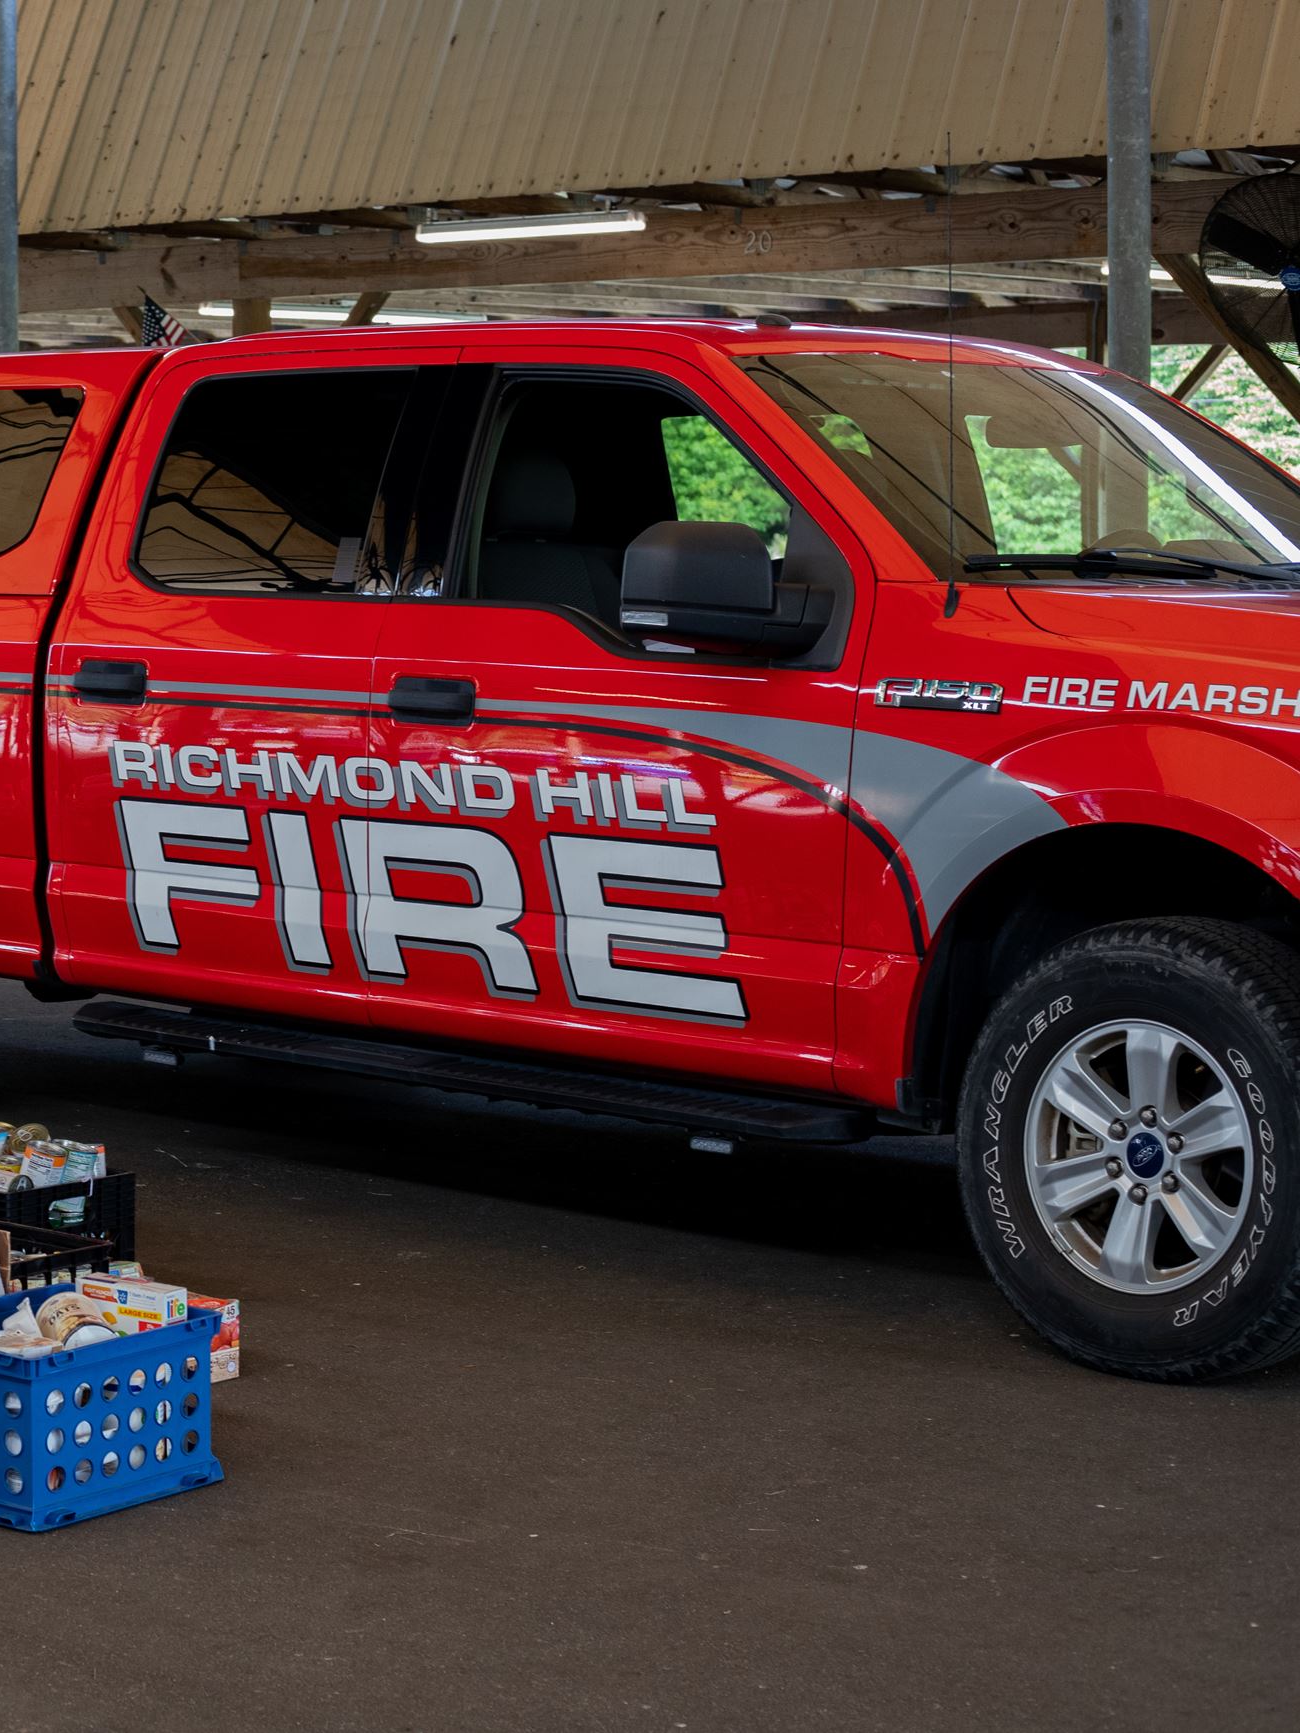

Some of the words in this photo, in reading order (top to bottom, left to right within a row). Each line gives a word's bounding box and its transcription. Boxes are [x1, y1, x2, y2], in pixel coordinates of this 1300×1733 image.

[745, 230, 772, 254] 20
[1022, 676, 1119, 708] FIRE
[962, 701, 990, 710] XLT
[112, 740, 514, 817] RICHMOND
[534, 768, 717, 832] HILL
[115, 798, 750, 1026] FIRE
[981, 994, 1074, 1260] WRANGLER
[49, 1303, 80, 1326] OATS
[119, 1306, 141, 1316] LARGE
[166, 1297, 186, 1319] life
[225, 1305, 236, 1316] 45
